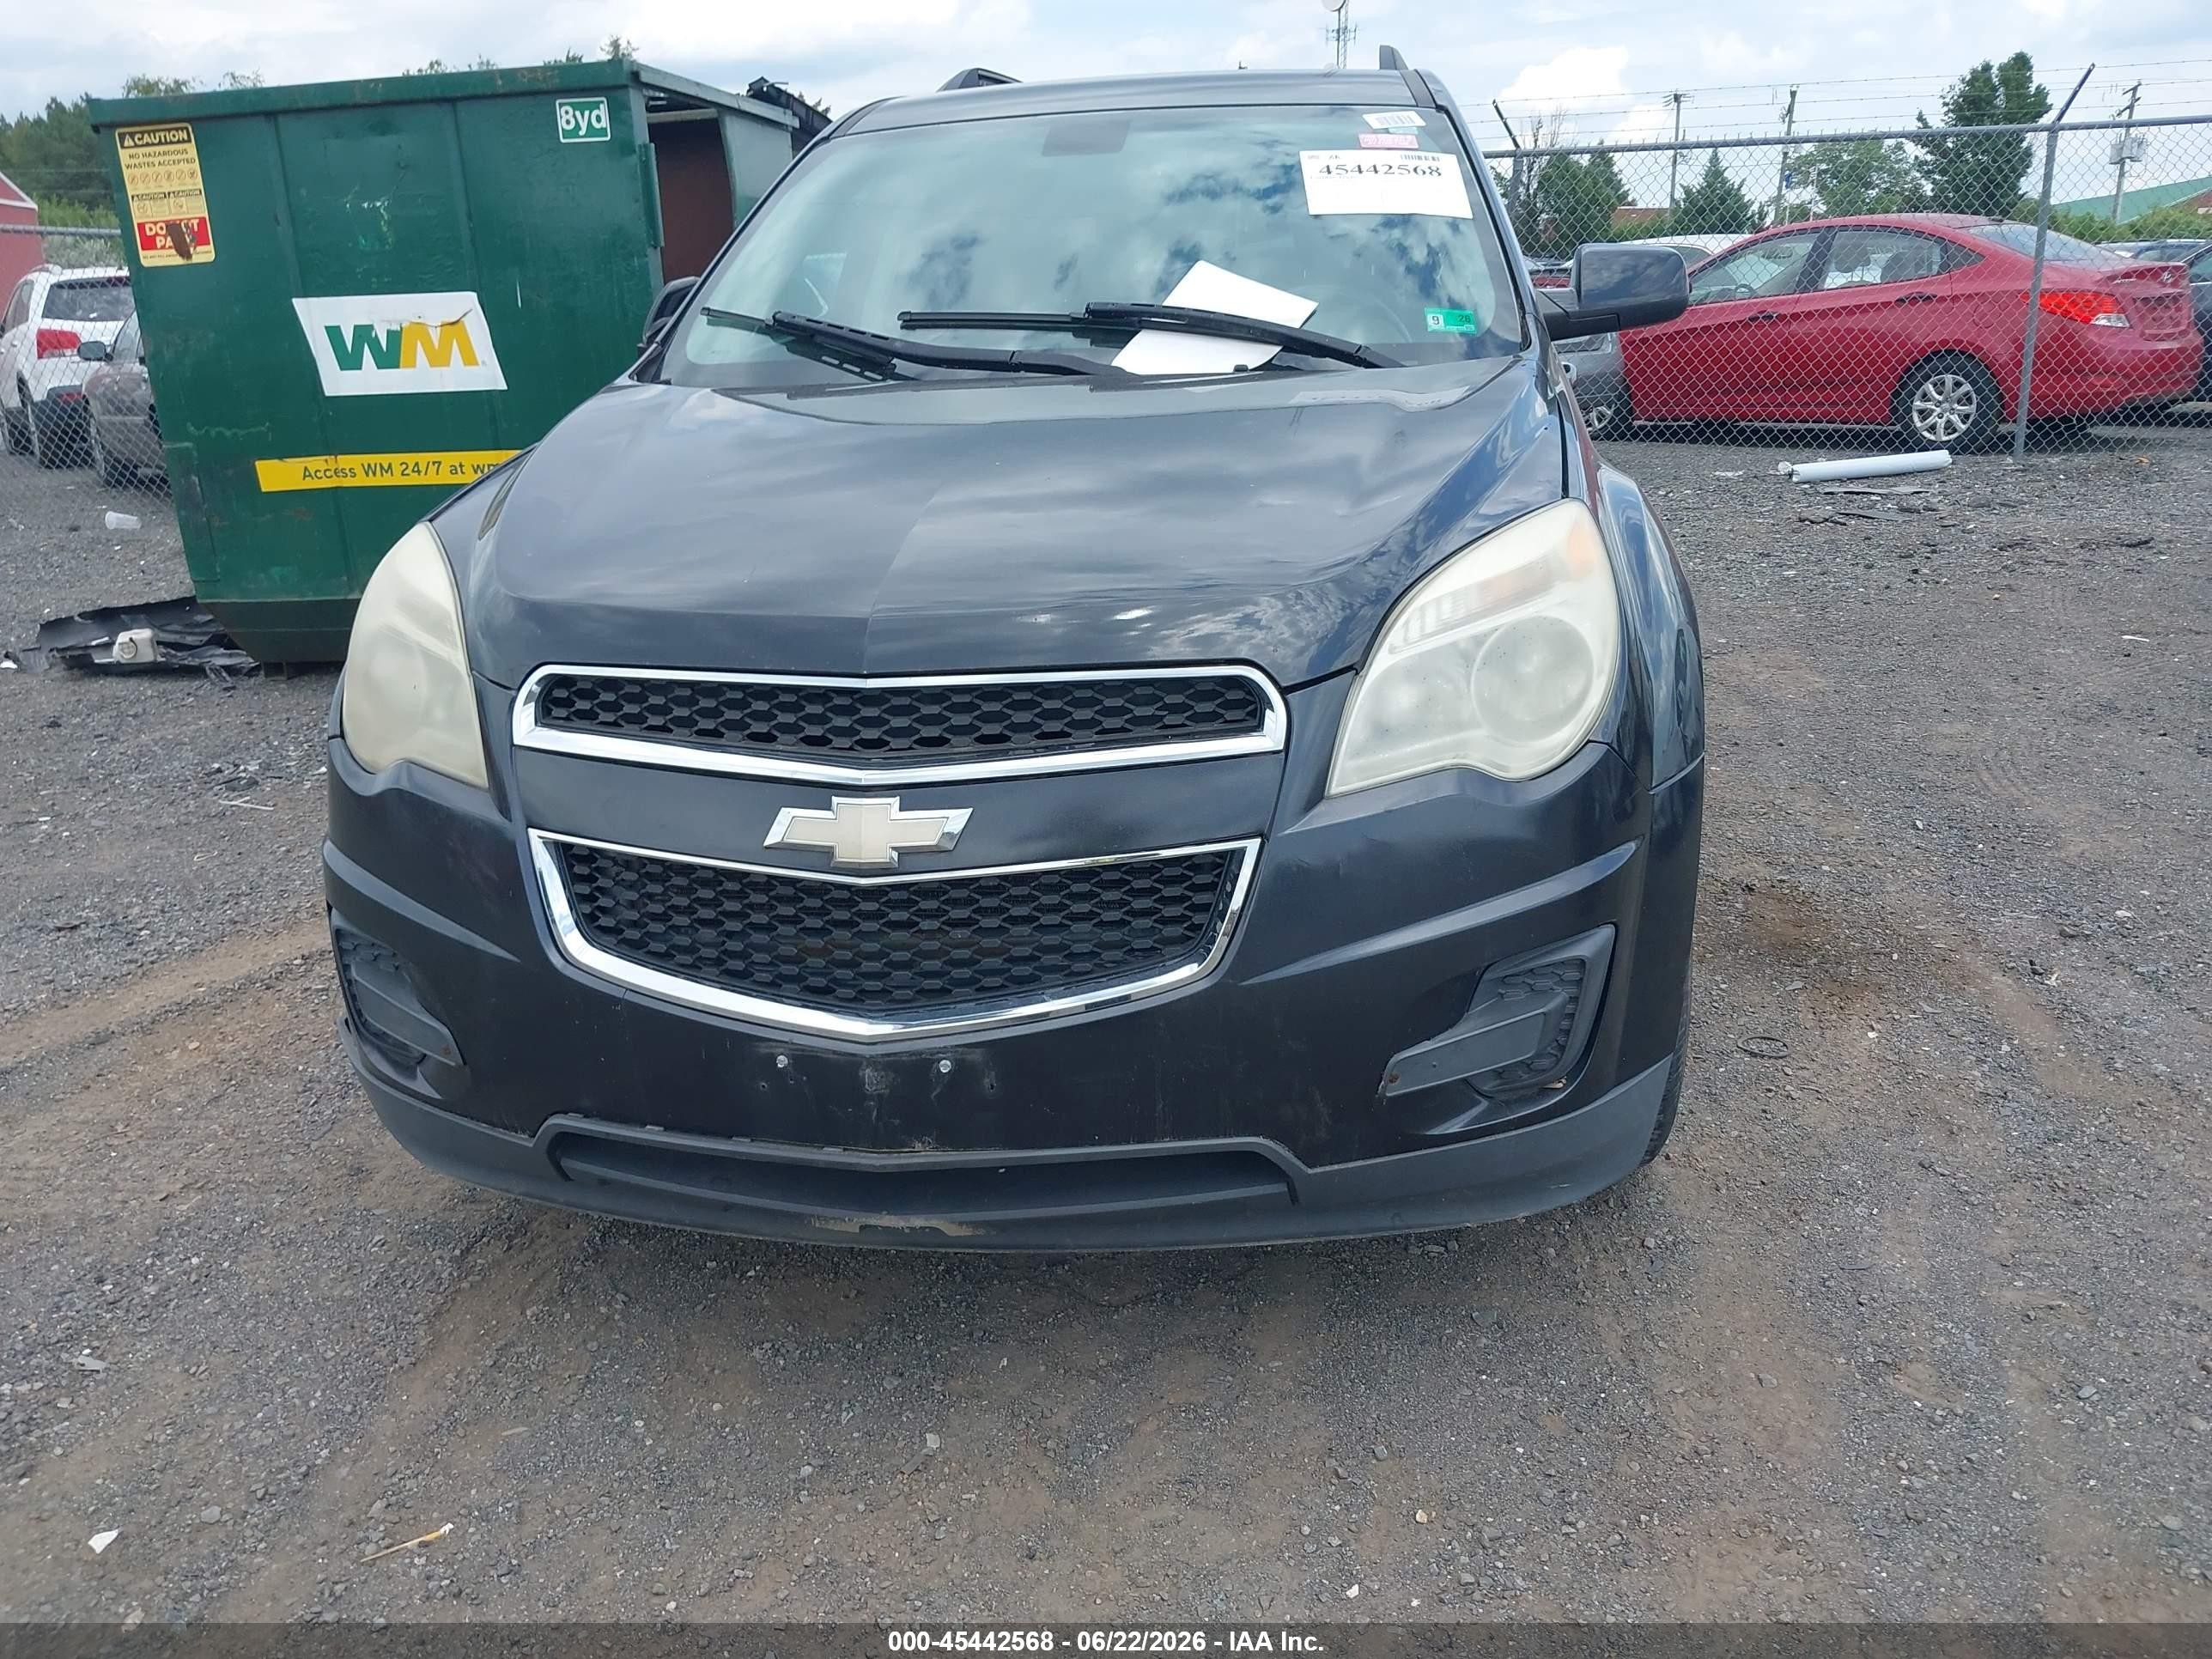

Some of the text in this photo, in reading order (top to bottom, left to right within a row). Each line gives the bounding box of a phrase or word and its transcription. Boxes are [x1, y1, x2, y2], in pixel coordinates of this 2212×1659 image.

[560, 103, 606, 136] 8yd
[134, 129, 188, 145] CAUTION
[142, 148, 189, 159] HAZARDOUS
[125, 157, 196, 170] WASTES ACCEPTED
[1319, 164, 1443, 177] 45442568
[144, 222, 167, 236] DO
[1431, 315, 1440, 325] 9
[324, 319, 480, 371] WM
[302, 465, 357, 481] Access
[361, 463, 394, 477] WM
[400, 460, 442, 477] 24/7
[449, 462, 465, 476] at
